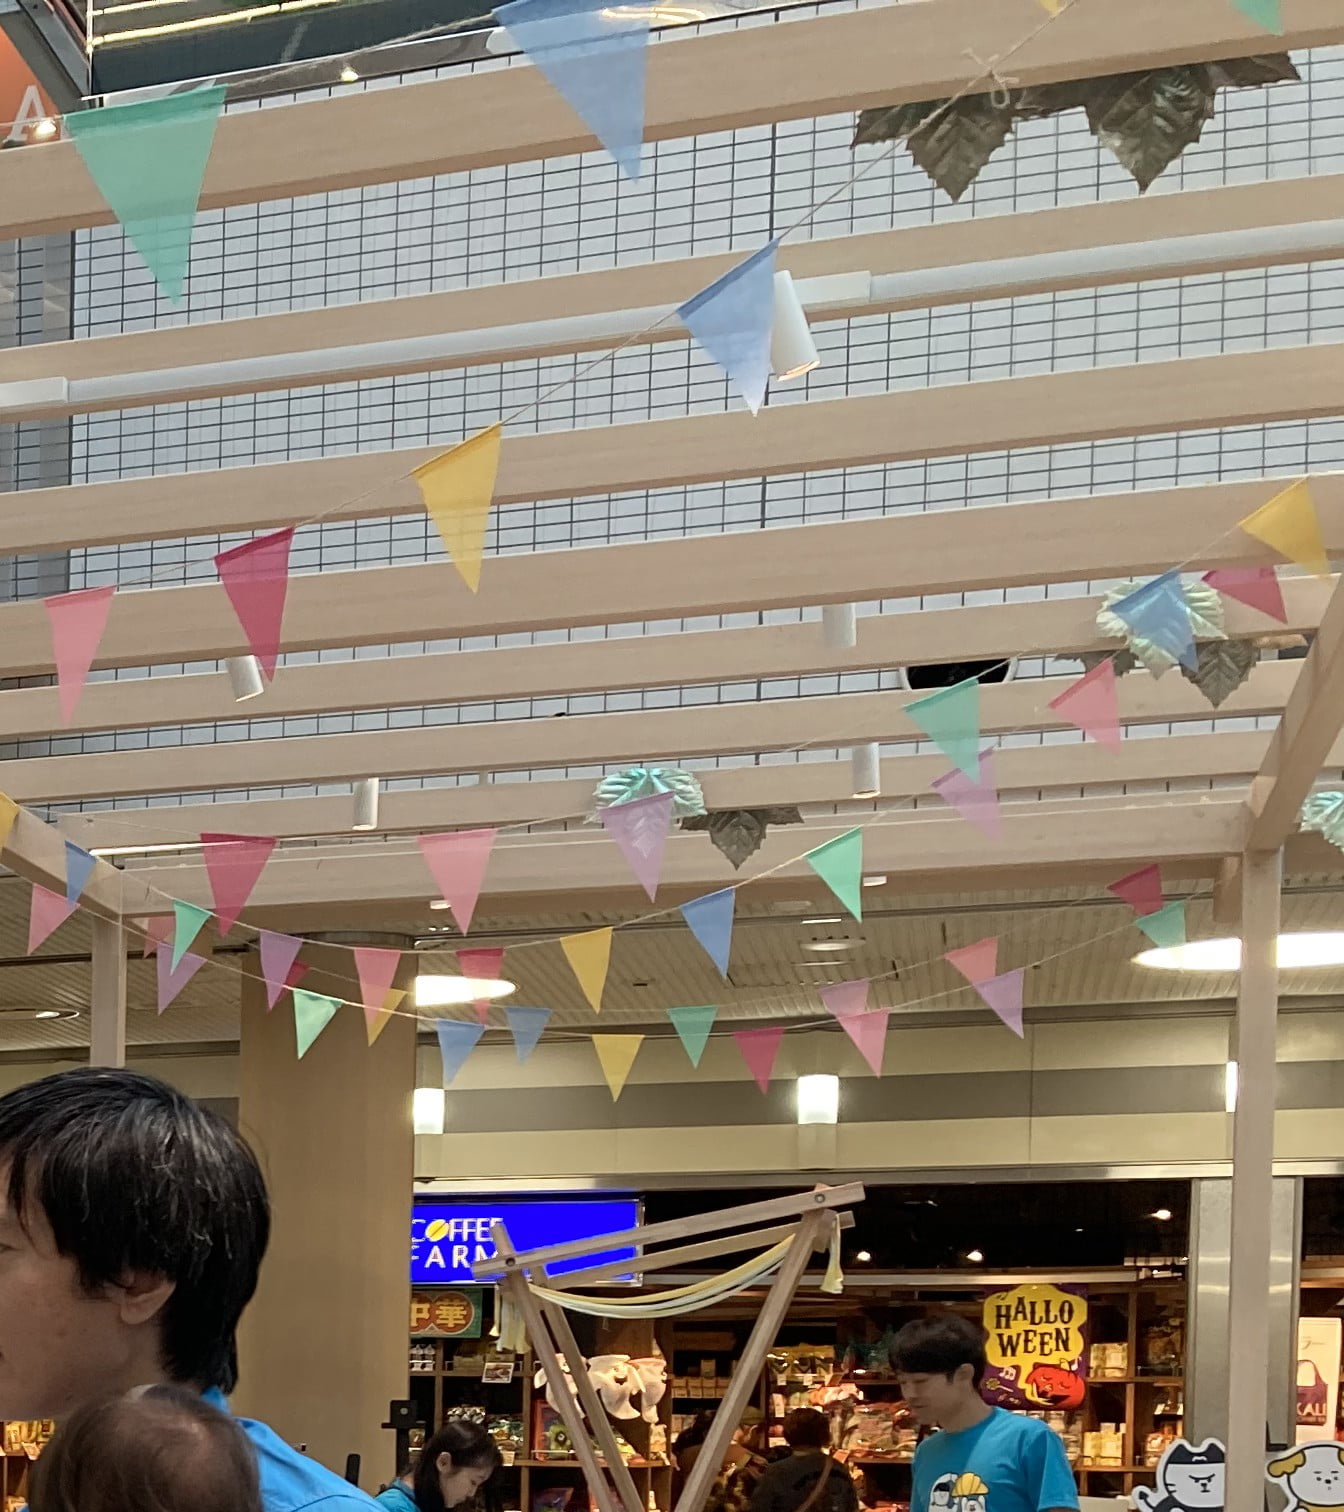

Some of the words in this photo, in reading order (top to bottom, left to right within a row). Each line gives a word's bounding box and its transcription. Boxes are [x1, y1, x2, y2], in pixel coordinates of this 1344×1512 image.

[411, 1217, 503, 1242] COFFE
[995, 1296, 1074, 1330] HALLO
[996, 1327, 1071, 1357] WEEN
